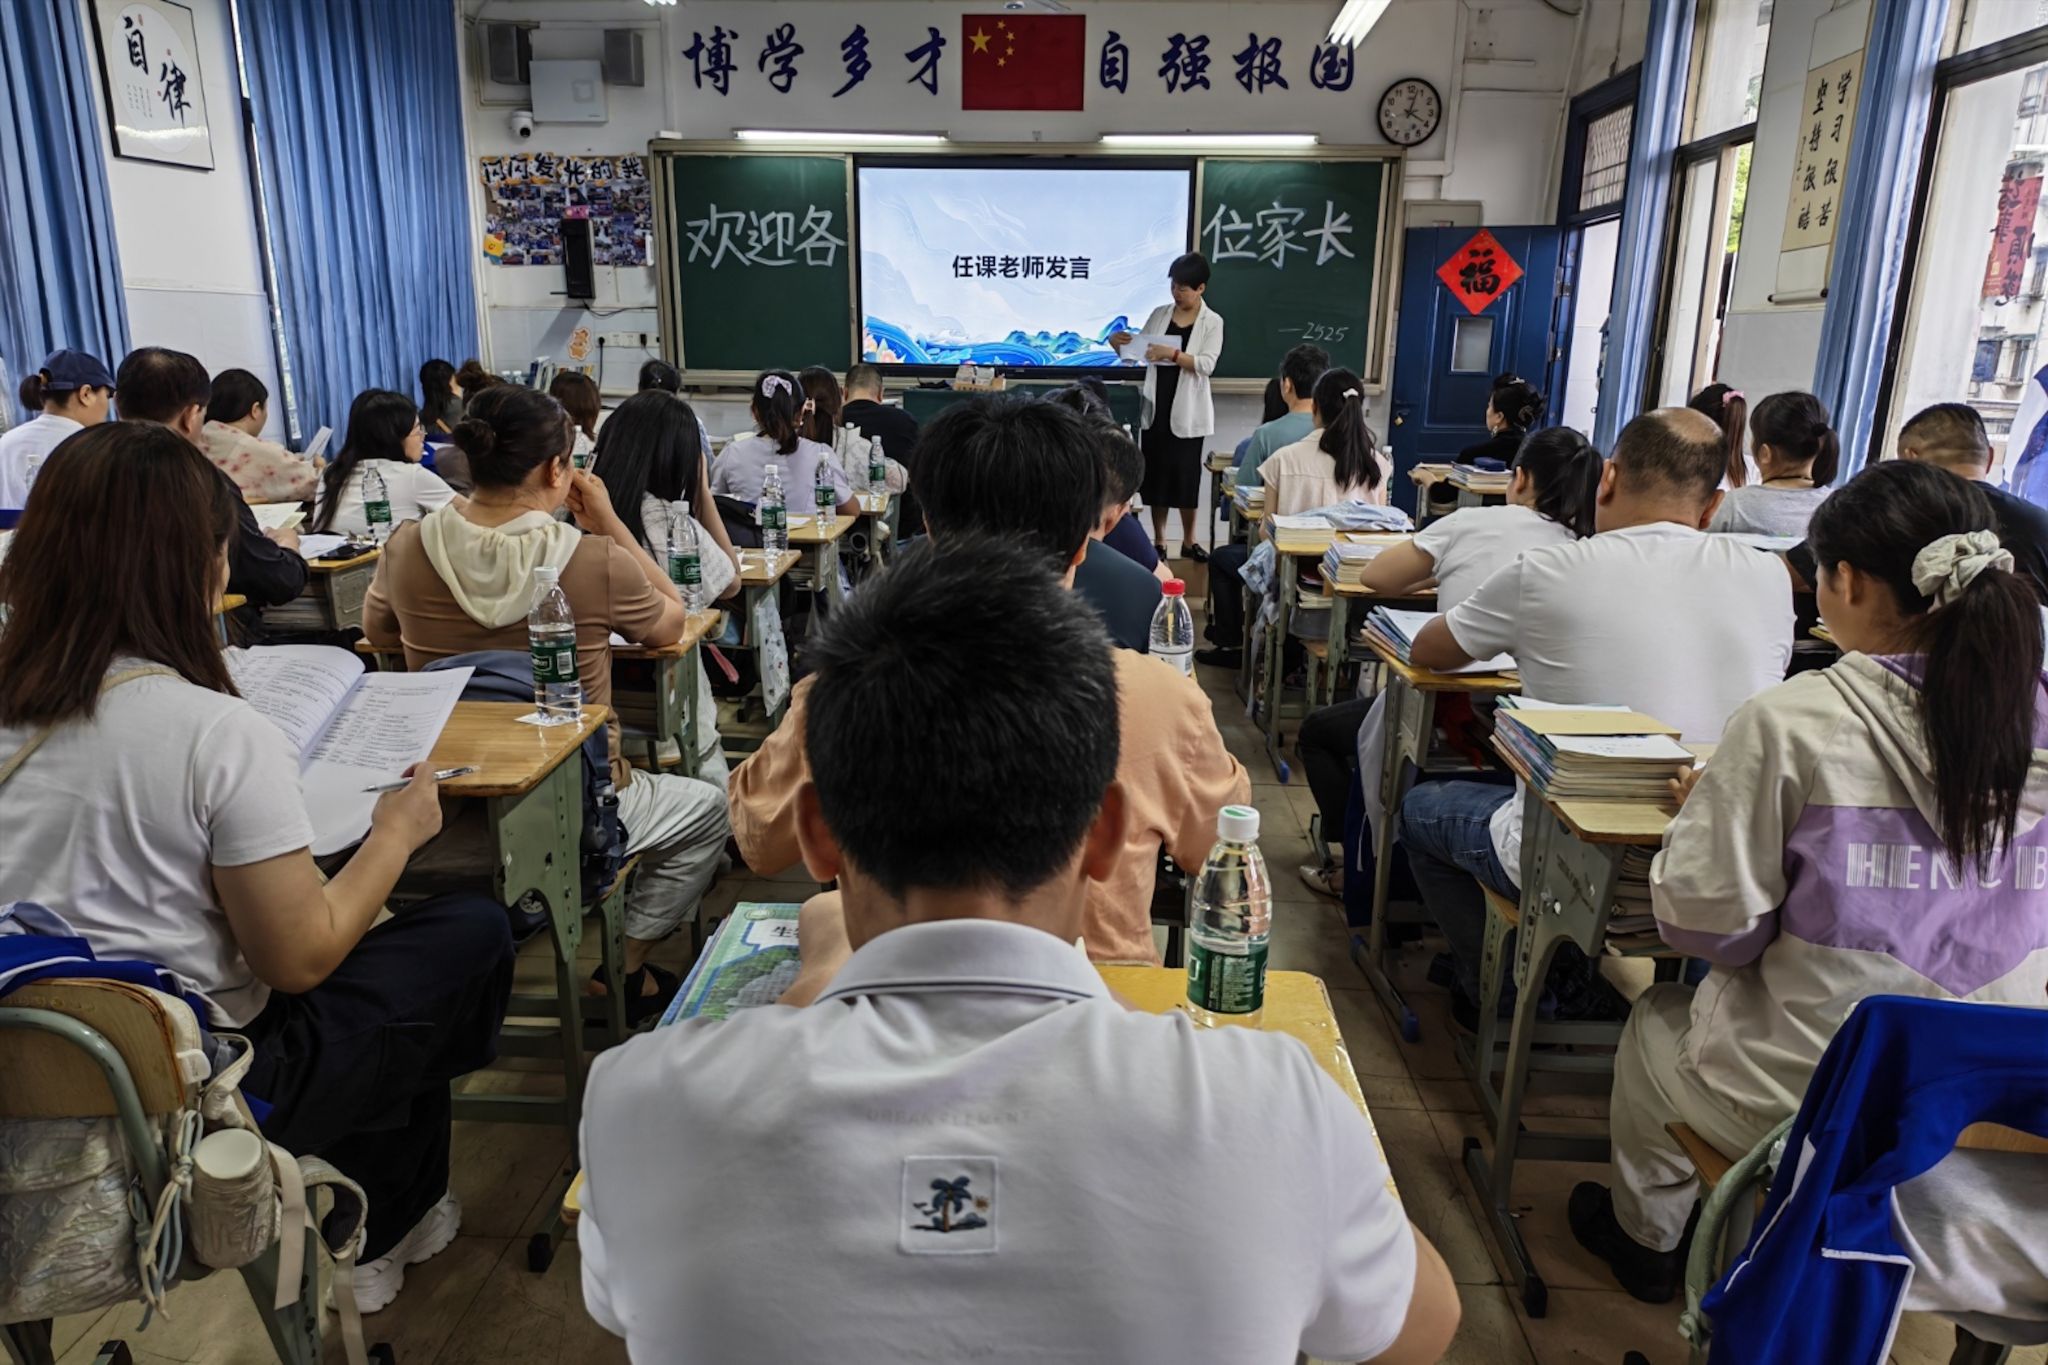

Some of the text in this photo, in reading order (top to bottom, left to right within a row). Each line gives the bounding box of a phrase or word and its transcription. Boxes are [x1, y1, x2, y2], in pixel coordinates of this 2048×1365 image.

[682, 22, 1354, 98] 博学多才 自强报国
[482, 153, 642, 184] 闪闪发光的我
[686, 199, 1355, 270] 欢迎各 位家长
[952, 255, 1091, 279] 任课老师发言
[1459, 248, 1501, 295] 福
